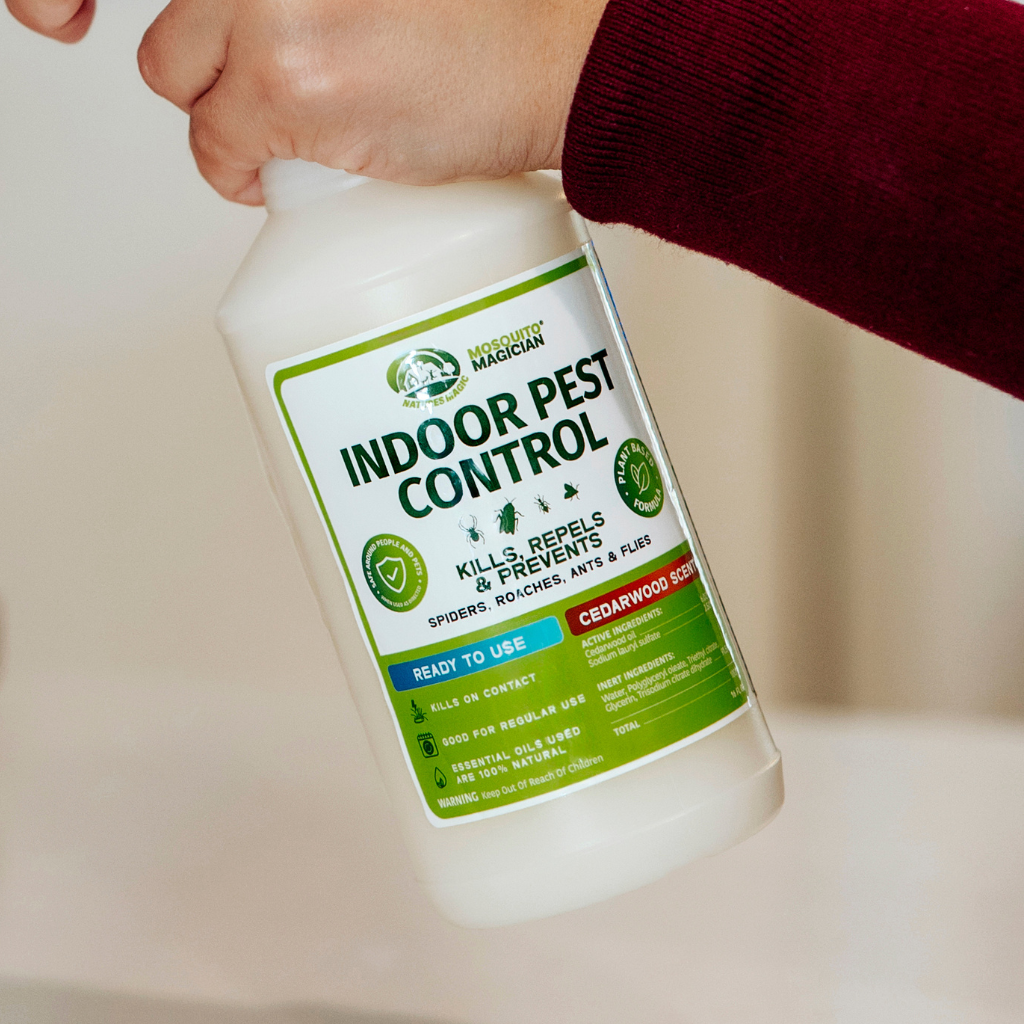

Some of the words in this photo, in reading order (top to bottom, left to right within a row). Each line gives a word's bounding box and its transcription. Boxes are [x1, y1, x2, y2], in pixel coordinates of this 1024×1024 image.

[467, 322, 541, 360] MOSQUITO
[471, 334, 545, 372] MAGICIAN
[339, 392, 528, 487] INDOOR
[527, 349, 614, 420] PEST
[402, 396, 445, 409] NATES
[398, 411, 609, 518] CONTROL
[617, 446, 631, 484] PLANT
[630, 442, 654, 467] BASED
[634, 488, 661, 513] FORMULA
[365, 543, 376, 570] AROUND
[376, 538, 400, 548] PEOPLE
[400, 544, 414, 558] AND
[455, 547, 524, 580] KILLS,
[527, 511, 605, 554] REPELS
[475, 576, 492, 593] &
[497, 532, 603, 585] PREVENTS
[366, 571, 376, 588] SAFE
[412, 557, 422, 576] PETS
[428, 601, 492, 628] SPIDERS,
[495, 573, 566, 607] ROACHES,
[570, 557, 604, 579] ANTS
[608, 551, 617, 563] &
[620, 534, 652, 557] FLIES
[579, 576, 669, 626] CEDARWOOD
[669, 559, 697, 584] SCENT
[581, 632, 612, 649] ACTIVE
[612, 607, 663, 636] INGREDIENTS:
[585, 637, 627, 658] Cedarwood
[627, 630, 637, 642] oil
[412, 658, 456, 682] READY
[461, 650, 485, 668] TO
[489, 636, 527, 658] USE
[588, 650, 617, 668] Sodium
[618, 639, 638, 656] lauryl
[639, 631, 661, 647] sulfate
[597, 675, 622, 692] INERT
[624, 652, 675, 680] INGREDIENTS:
[605, 694, 638, 713] Glycerin,
[638, 679, 671, 699] Trisodium
[671, 667, 690, 684] citrate
[430, 698, 460, 712] KILLS
[463, 692, 479, 704] ON
[483, 673, 536, 698] CONTACT
[442, 733, 469, 747] GOOD
[472, 725, 496, 739] FOR
[500, 704, 557, 731] REGULAR
[561, 694, 586, 710] USE
[613, 720, 641, 736] TOTAL
[451, 751, 511, 773] ESSENTIAL
[515, 739, 543, 756] OILS
[547, 726, 581, 745] USED
[456, 773, 475, 785] ARE
[479, 765, 508, 779] 100%
[512, 746, 567, 770] NATURAL
[437, 791, 479, 809] WARNING
[481, 790, 501, 802] Keep
[501, 784, 517, 796] Out
[518, 778, 529, 790] Of
[529, 772, 554, 786] Reach
[556, 766, 567, 777] Of
[568, 755, 604, 773] Children
